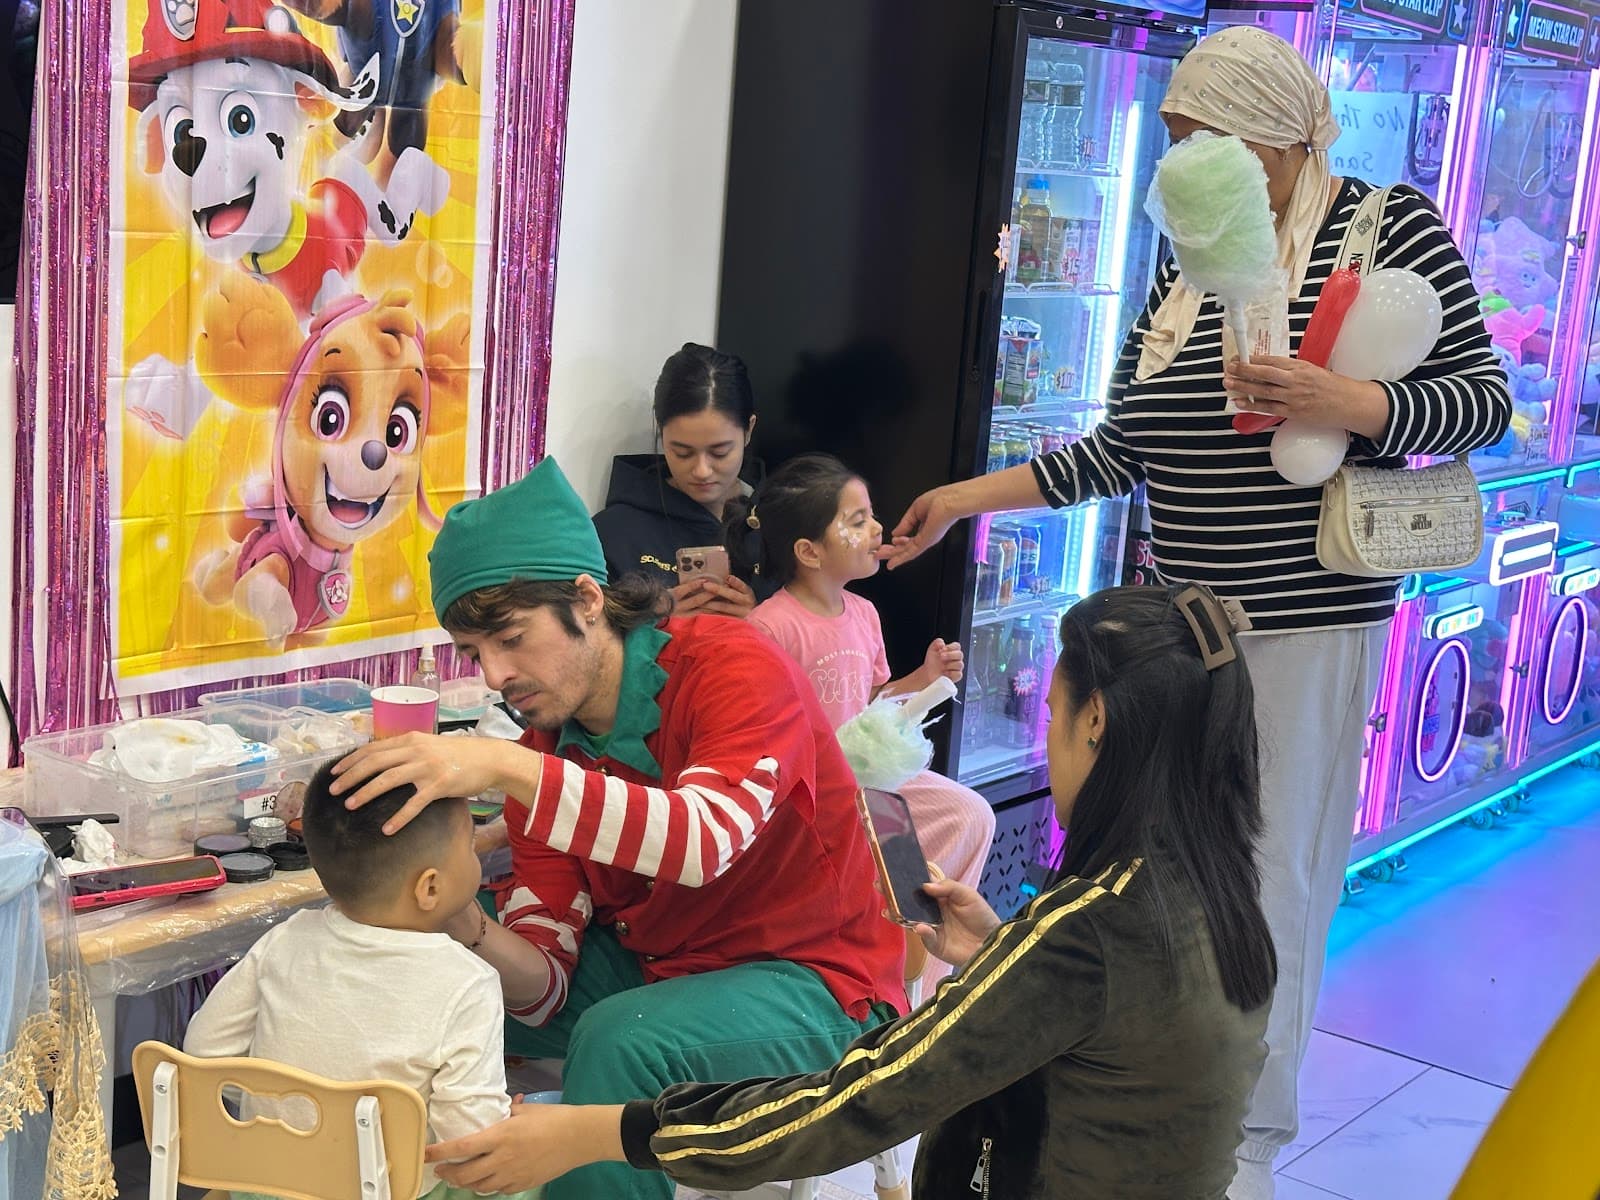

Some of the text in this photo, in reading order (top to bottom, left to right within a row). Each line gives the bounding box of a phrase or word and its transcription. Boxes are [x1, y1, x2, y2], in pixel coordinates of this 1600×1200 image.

[1528, 15, 1585, 48] MEOW STAR CLIP
[816, 650, 838, 667] MOST
[261, 795, 278, 812] #3
